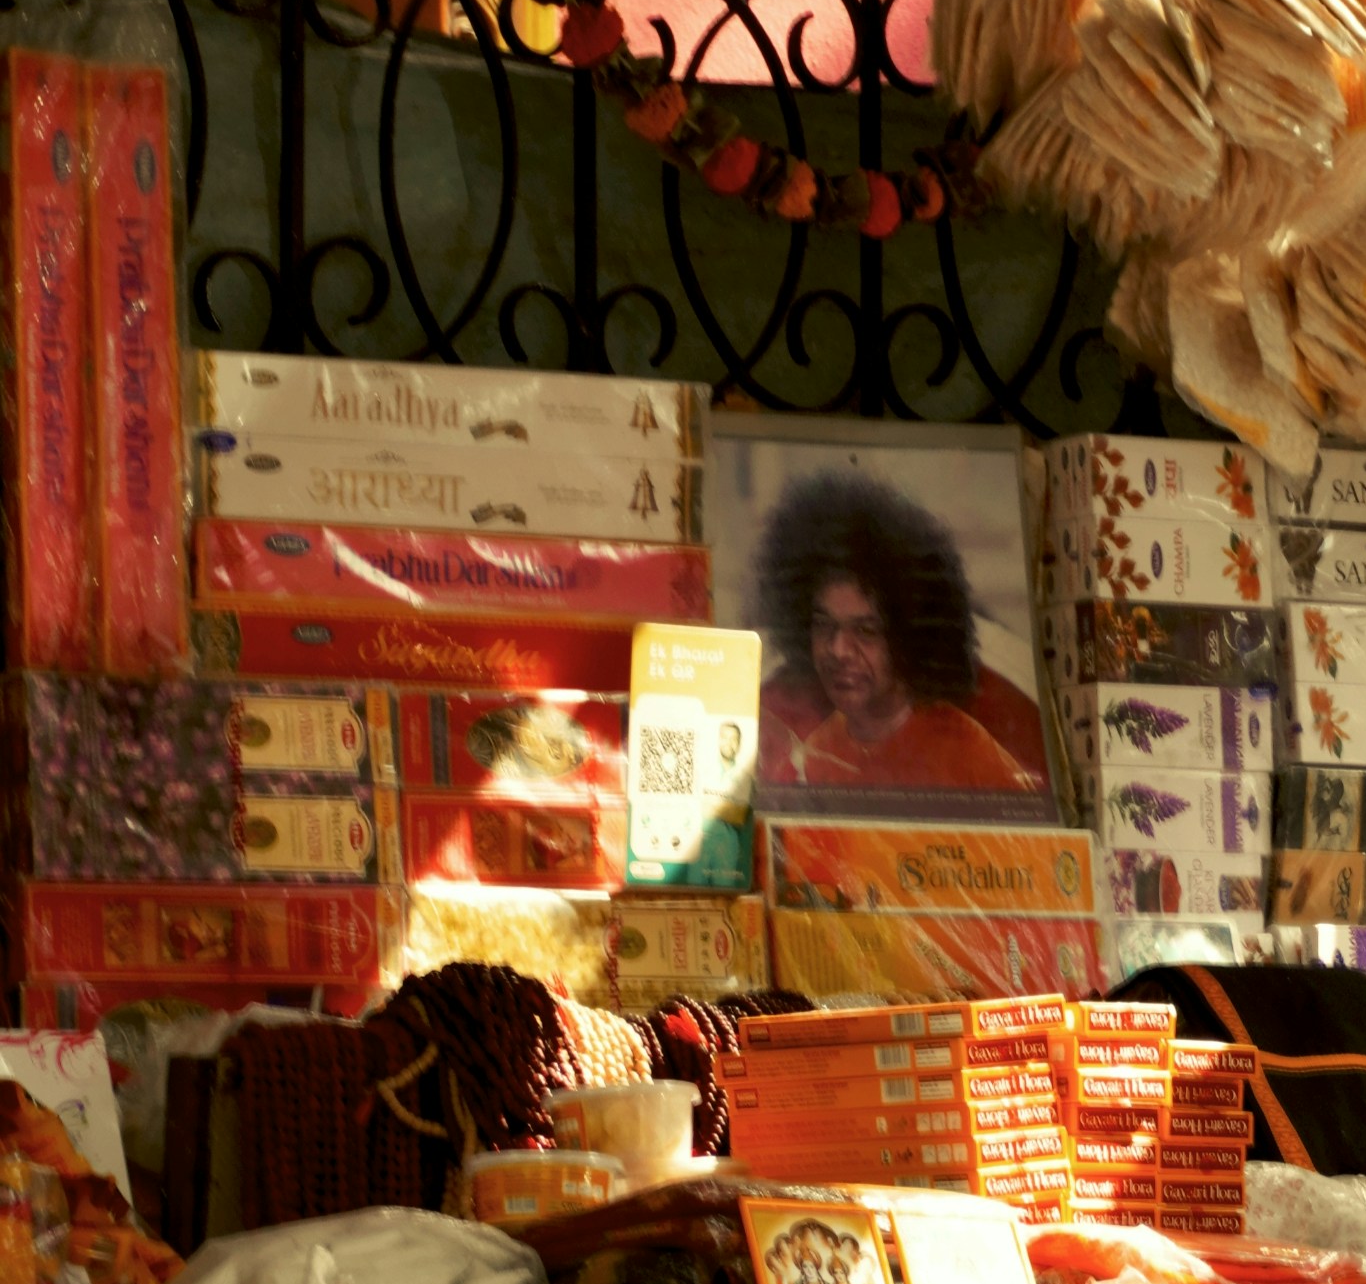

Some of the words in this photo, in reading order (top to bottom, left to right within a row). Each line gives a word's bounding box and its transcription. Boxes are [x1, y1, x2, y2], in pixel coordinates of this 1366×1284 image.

[312, 378, 462, 432] Aaradhya
[1173, 527, 1185, 597] CHAMPA
[1203, 693, 1216, 762] LAVENDER
[1204, 778, 1216, 846] LAVENDER
[897, 852, 1034, 892] Sandalum
[1028, 1004, 1062, 1023] Flora
[1014, 1040, 1047, 1058] Flora
[1222, 1052, 1253, 1069] Flora
[1019, 1073, 1053, 1091] Flora
[1128, 1077, 1165, 1098] Flora
[1125, 1112, 1156, 1131] Flora
[1033, 1169, 1067, 1191] Flora
[1122, 1178, 1153, 1195] Flora
[1209, 1185, 1241, 1201] Flora
